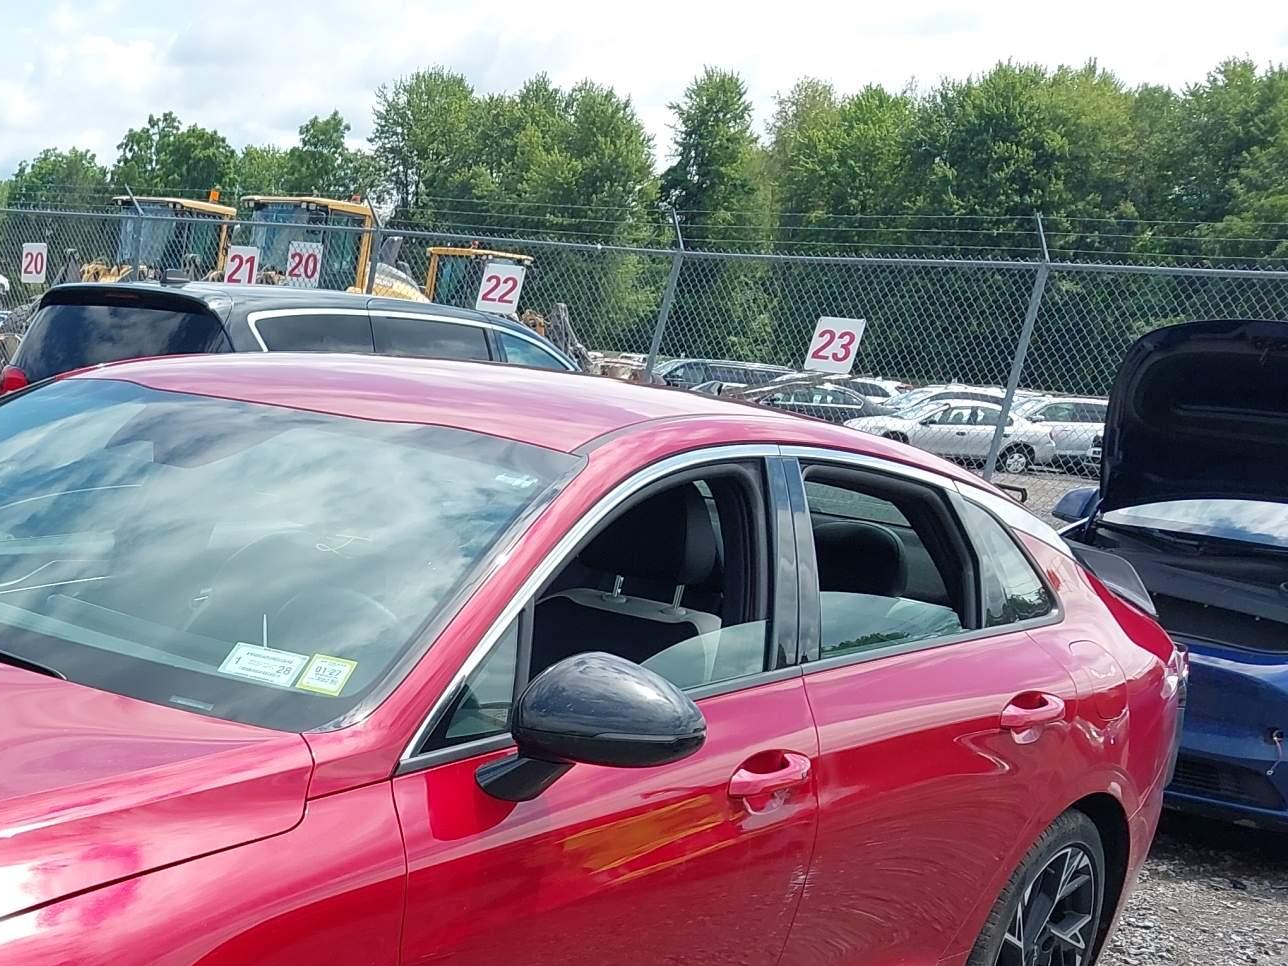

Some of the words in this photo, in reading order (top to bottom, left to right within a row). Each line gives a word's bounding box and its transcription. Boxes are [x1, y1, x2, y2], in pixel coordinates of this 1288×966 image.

[23, 252, 44, 275] 20
[227, 254, 256, 284] 21
[288, 252, 318, 279] 20
[482, 275, 518, 304] 22
[811, 329, 856, 362] 23
[276, 666, 293, 676] 28
